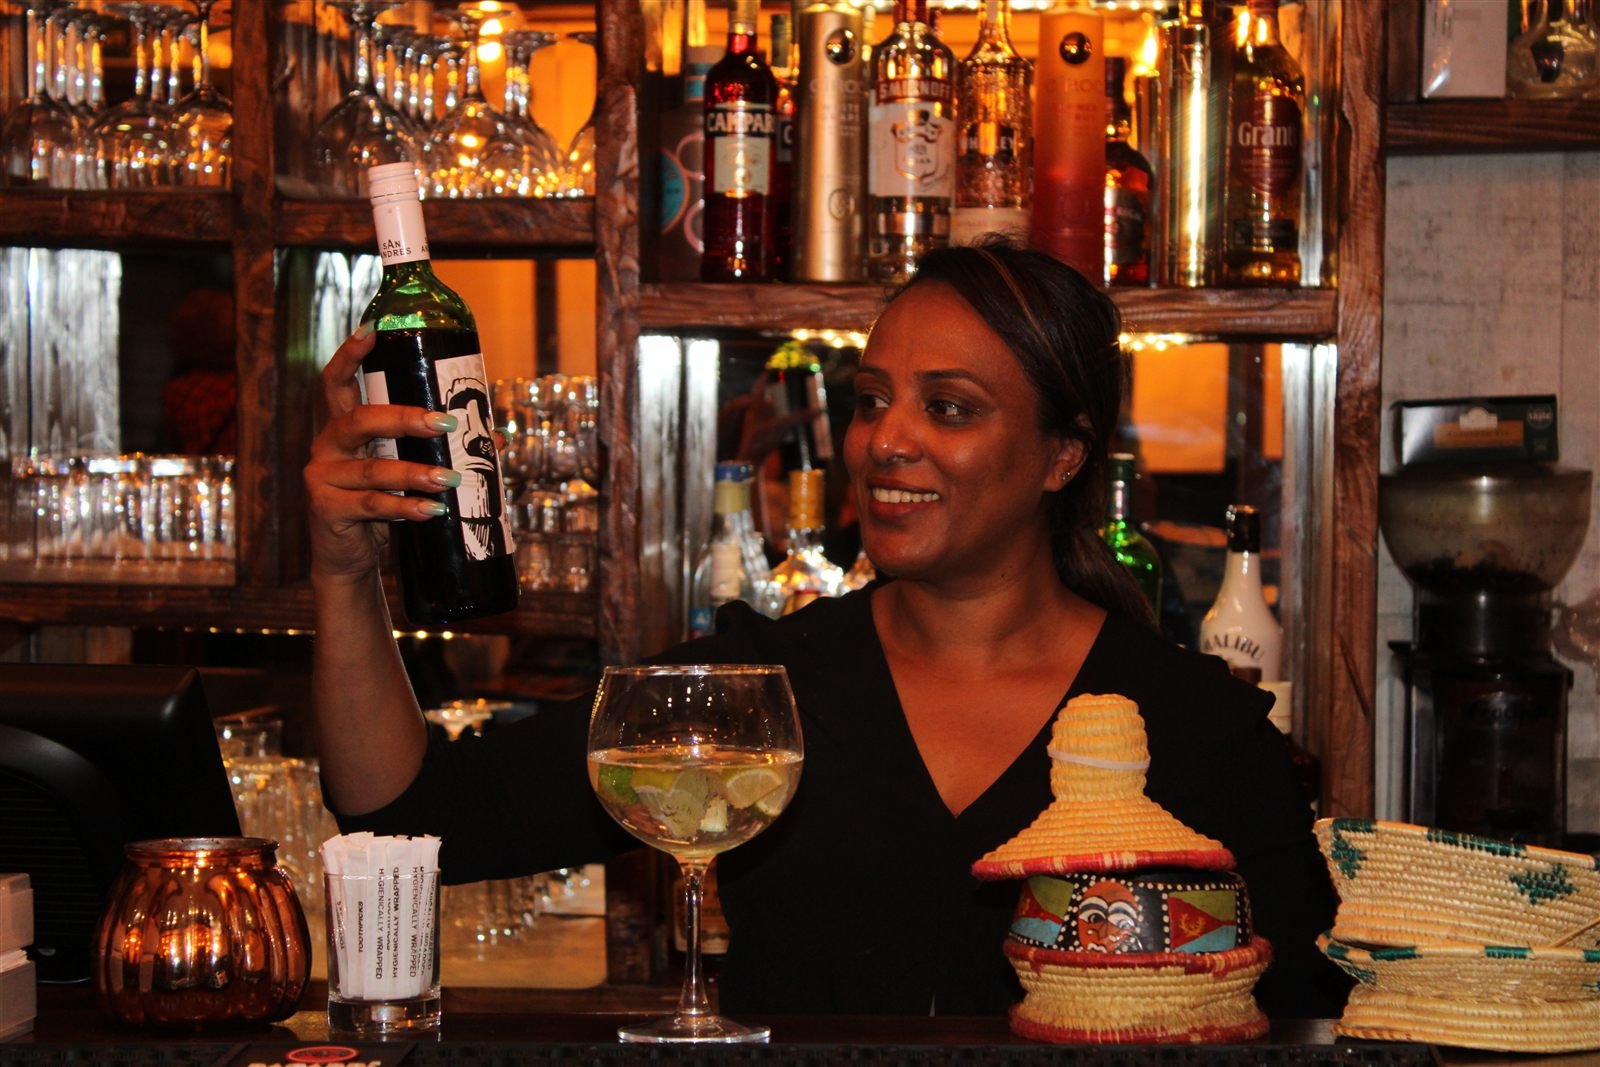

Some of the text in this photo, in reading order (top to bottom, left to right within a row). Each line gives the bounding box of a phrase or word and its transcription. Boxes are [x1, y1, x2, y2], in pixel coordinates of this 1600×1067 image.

[707, 111, 776, 133] CAMPAR
[392, 867, 400, 912] WRAPPED
[411, 866, 419, 930] HYGIENICALLY
[375, 868, 385, 980] HGIENICALLY WRAPPED
[409, 934, 418, 978] WRAPPED
